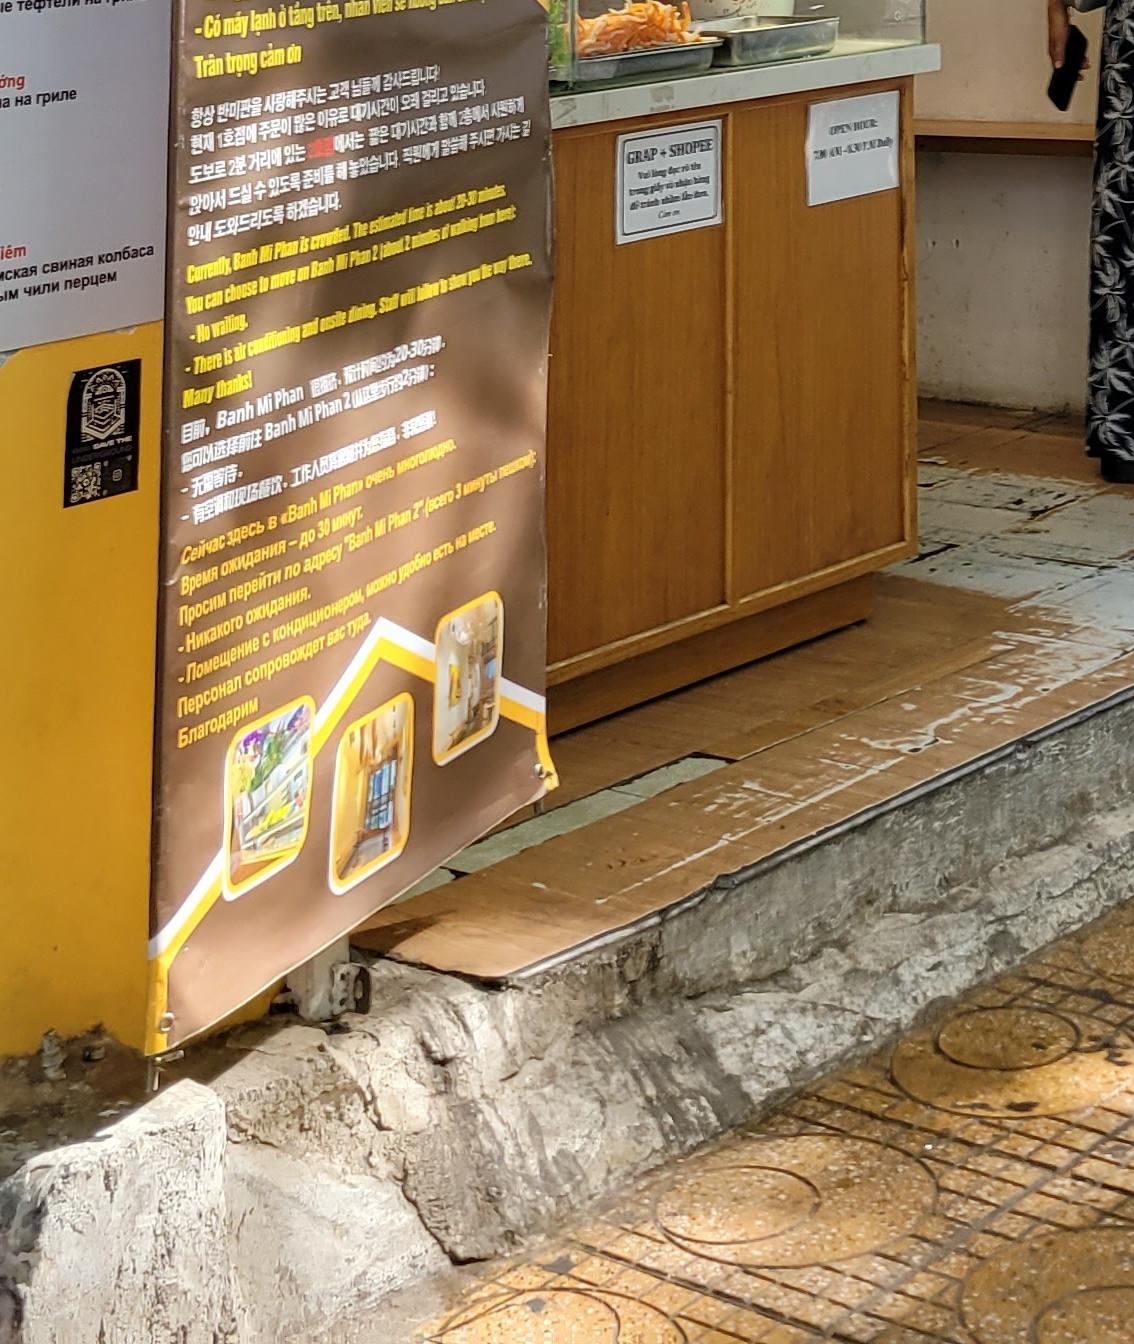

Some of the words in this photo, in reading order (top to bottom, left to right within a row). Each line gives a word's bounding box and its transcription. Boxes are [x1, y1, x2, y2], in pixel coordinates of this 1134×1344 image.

[194, 54, 223, 79] Trân
[226, 52, 257, 78] trọng
[260, 43, 284, 69] cảm
[287, 44, 301, 64] ơn
[669, 139, 712, 157] SHOPEE
[188, 221, 211, 246] 안내
[213, 204, 284, 238] 도와드리도록
[43, 255, 93, 274] свиная
[98, 244, 154, 265] колбаса
[24, 283, 60, 298] чили
[64, 271, 117, 292] перцем
[183, 386, 215, 409] Many
[216, 370, 253, 399] thanks!
[181, 535, 226, 566] Сейчас
[227, 520, 265, 547] здесь
[268, 515, 277, 528] в
[366, 467, 395, 489] очень
[180, 569, 218, 597] Время
[221, 543, 287, 577] ожидания
[299, 532, 316, 551] до
[318, 519, 330, 540] 30
[178, 696, 259, 749] Благодарим
